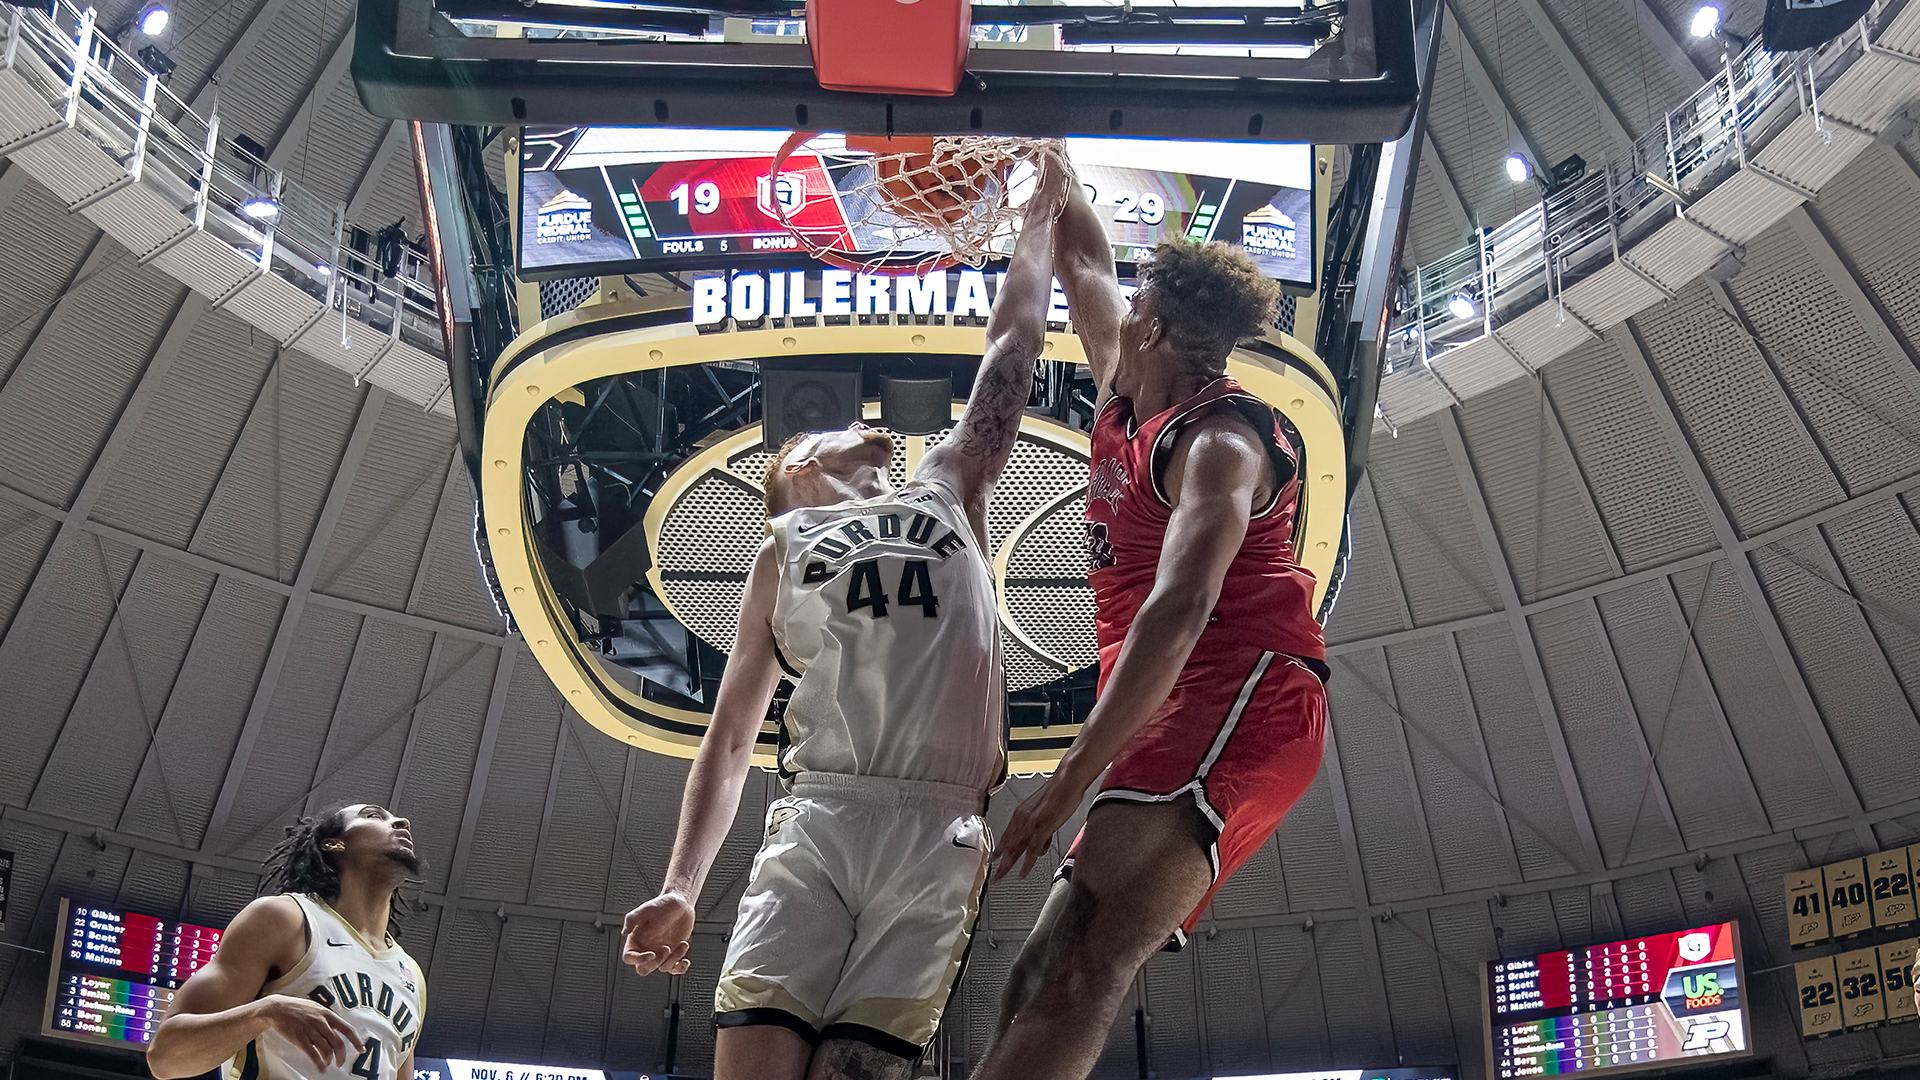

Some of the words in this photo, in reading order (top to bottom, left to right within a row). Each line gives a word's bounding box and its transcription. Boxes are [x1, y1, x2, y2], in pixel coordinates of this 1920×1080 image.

[670, 182, 720, 215] 19
[1113, 190, 1165, 225] 29
[537, 223, 591, 237] FEDERAL
[538, 212, 592, 226] PURDUE
[663, 240, 704, 253] FOULS
[720, 240, 728, 251] 5
[753, 237, 798, 249] BONUS
[1243, 224, 1296, 242] PURDUE
[1244, 236, 1295, 252] FEDERAL
[1244, 246, 1269, 255] CREDIT
[1272, 250, 1296, 259] UNION
[693, 268, 1135, 326] BOILERMAE
[803, 513, 967, 584] PURDUE
[847, 560, 939, 619] 44
[1832, 882, 1865, 908] 40
[1873, 873, 1909, 900] 22
[1793, 892, 1820, 917] 41
[75, 918, 85, 927] 22
[90, 921, 125, 934] Graber
[155, 933, 162, 941] 3
[193, 940, 199, 948] 3
[211, 944, 218, 952] 0
[77, 908, 87, 916] 10
[91, 910, 120, 922] Gibbs
[156, 922, 164, 931] 2
[177, 926, 182, 934] 1
[195, 930, 200, 938] 1
[212, 933, 219, 941] 0
[72, 940, 82, 948] 30
[87, 942, 120, 954] Sefton
[153, 954, 160, 962] 0
[172, 958, 178, 966] 0
[191, 961, 197, 969] 0
[73, 929, 84, 937] 23
[88, 931, 117, 943] Scott
[175, 947, 179, 955] 1
[192, 951, 198, 959] 2
[1507, 961, 1533, 970] Gibbs
[1567, 953, 1573, 961] 2
[1586, 950, 1591, 958] 1
[1604, 947, 1608, 955] 1
[1620, 944, 1627, 953] 0
[1638, 941, 1645, 950] 0
[70, 951, 81, 959] 50
[85, 952, 122, 966] Malone
[151, 965, 158, 973] 3
[170, 968, 177, 976] 2
[1495, 975, 1504, 983] 22
[1508, 970, 1540, 980] Graber
[1568, 964, 1574, 972] 3
[1586, 961, 1592, 969] 0
[1604, 958, 1610, 966] 3
[1621, 954, 1628, 963] 0
[1639, 952, 1646, 960] 0
[71, 976, 77, 984] 2
[82, 977, 111, 989] Loyer
[148, 989, 155, 997] 0
[1496, 985, 1505, 993] 23
[1509, 980, 1534, 991] Scott
[1569, 974, 1575, 982] 2
[1588, 971, 1592, 979] 1
[1605, 968, 1611, 976] 2
[1622, 965, 1628, 973] 0
[1641, 962, 1647, 971] 0
[1497, 995, 1506, 1003] 30
[1509, 990, 1540, 1001] Sefton
[1570, 984, 1576, 992] 0
[1588, 981, 1594, 989] 0
[1605, 978, 1612, 987] 0
[1623, 975, 1630, 984] 0
[1641, 972, 1648, 981] 0
[1682, 973, 1724, 999] US.
[1843, 973, 1878, 999] 32
[80, 988, 110, 1000] Smith
[1497, 1005, 1506, 1013] 50
[1571, 994, 1577, 1003] 3
[1589, 991, 1595, 1000] 2
[1607, 988, 1612, 997] 1
[1624, 986, 1631, 994] 0
[1642, 983, 1649, 991] 0
[1625, 998, 1631, 1006] B
[1686, 995, 1721, 1009] FOODS
[1801, 982, 1835, 1009] 22
[62, 1008, 72, 1016] 44
[77, 1010, 102, 1023] Berg
[144, 1021, 151, 1030] 0
[75, 1021, 107, 1033] Jones
[1512, 1025, 1538, 1035] Loyer
[1572, 1018, 1579, 1026] 0
[1590, 1015, 1597, 1024] 0
[1608, 1013, 1615, 1021] 0
[1627, 1010, 1633, 1018] 0
[1644, 1007, 1651, 1015] 0
[1513, 1034, 1540, 1045] Smith
[1593, 1026, 1598, 1034] 1
[1609, 1023, 1616, 1031] 2
[1628, 1020, 1634, 1029] 0
[1648, 1018, 1652, 1026] 1
[1574, 1038, 1581, 1047] 0
[1592, 1036, 1599, 1045] 0
[1612, 1033, 1616, 1042] 1
[1628, 1031, 1635, 1039] 0
[1647, 1028, 1654, 1037] 0
[1682, 1020, 1730, 1051] P
[352, 1036, 381, 1080] 4
[1501, 1059, 1510, 1067] 44
[1575, 1049, 1582, 1058] 0
[1594, 1047, 1599, 1055] 1
[1611, 1044, 1618, 1052] 0
[1629, 1041, 1636, 1050] 0
[1648, 1038, 1655, 1047] 0
[1502, 1070, 1511, 1078] 55
[1515, 1066, 1543, 1076] Jones
[1594, 1057, 1600, 1066] 2
[1612, 1054, 1619, 1063] 0
[1630, 1052, 1637, 1061] 0
[1649, 1049, 1656, 1058] 0
[471, 1068, 500, 1080] NOV.
[506, 1071, 514, 1080] 6
